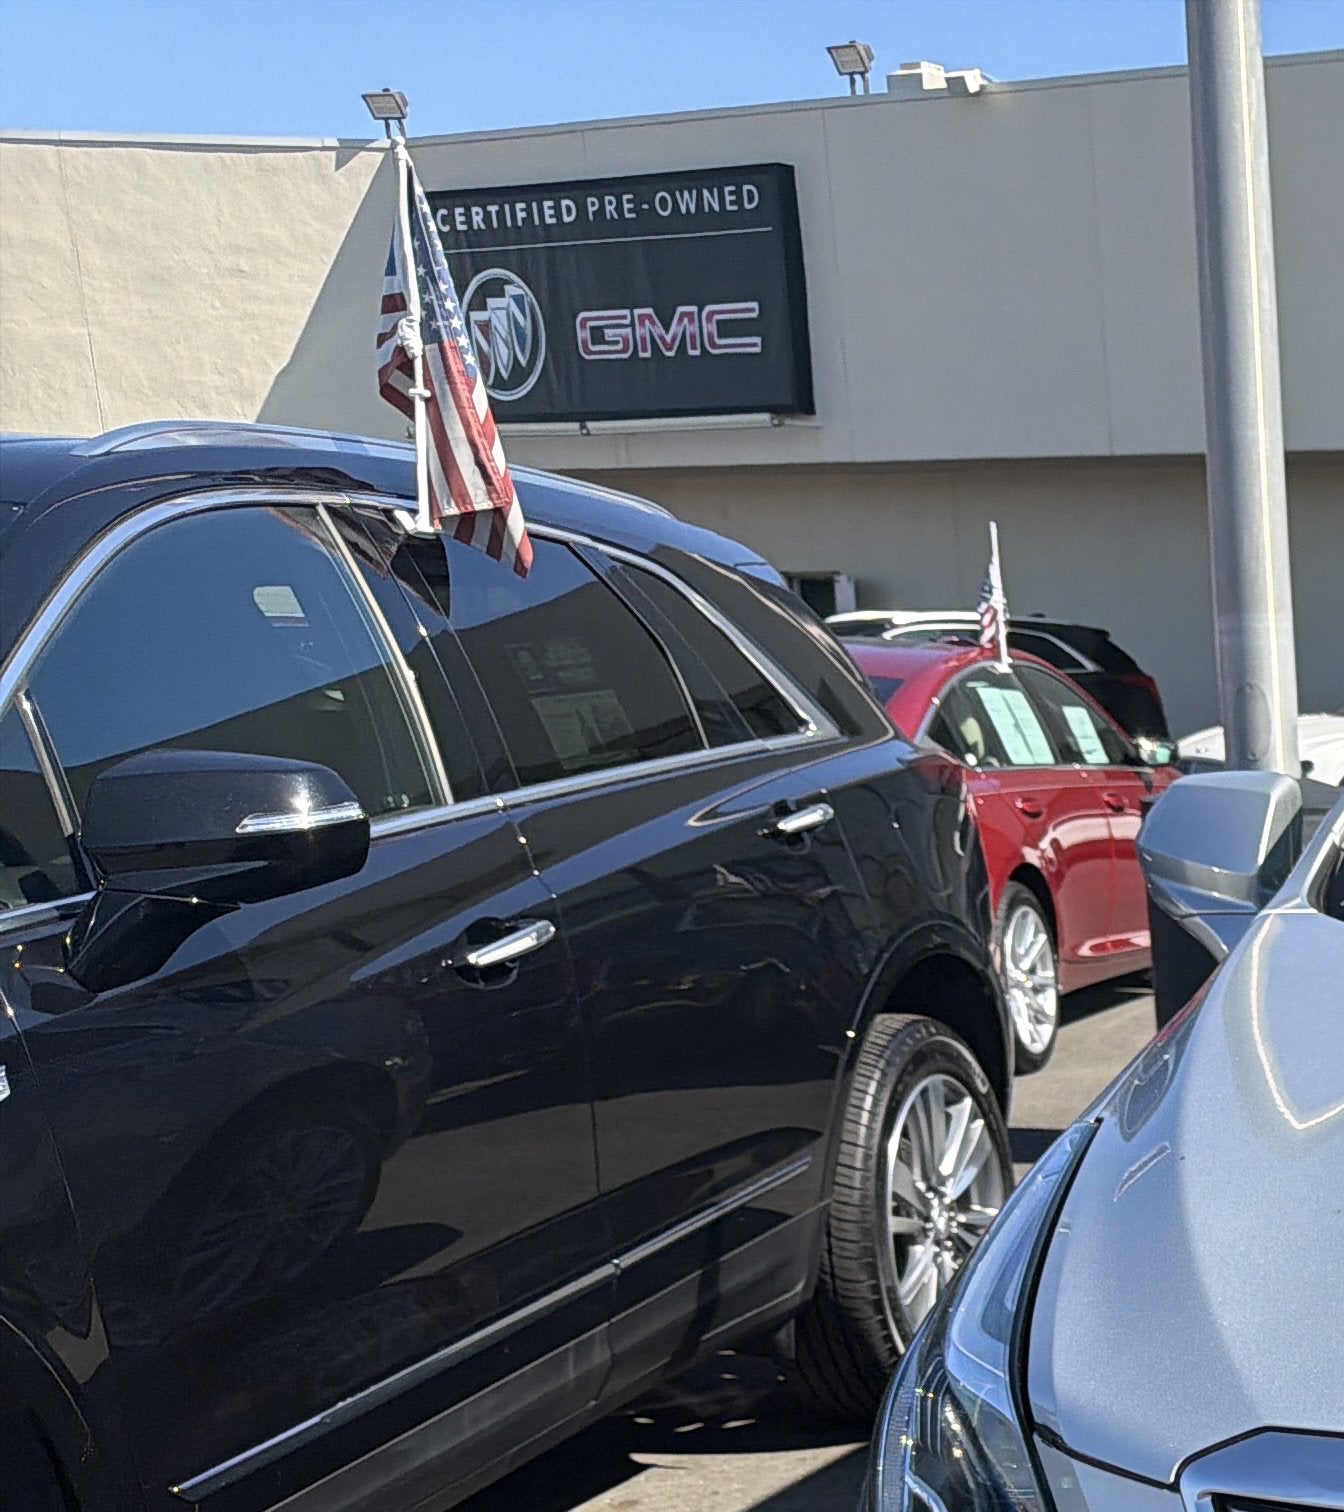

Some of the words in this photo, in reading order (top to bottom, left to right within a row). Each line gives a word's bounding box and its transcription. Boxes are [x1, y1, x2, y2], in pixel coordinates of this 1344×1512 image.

[436, 199, 577, 232] CERTIFIED
[587, 184, 760, 221] PRE-OWNED
[576, 302, 761, 360] GMC
